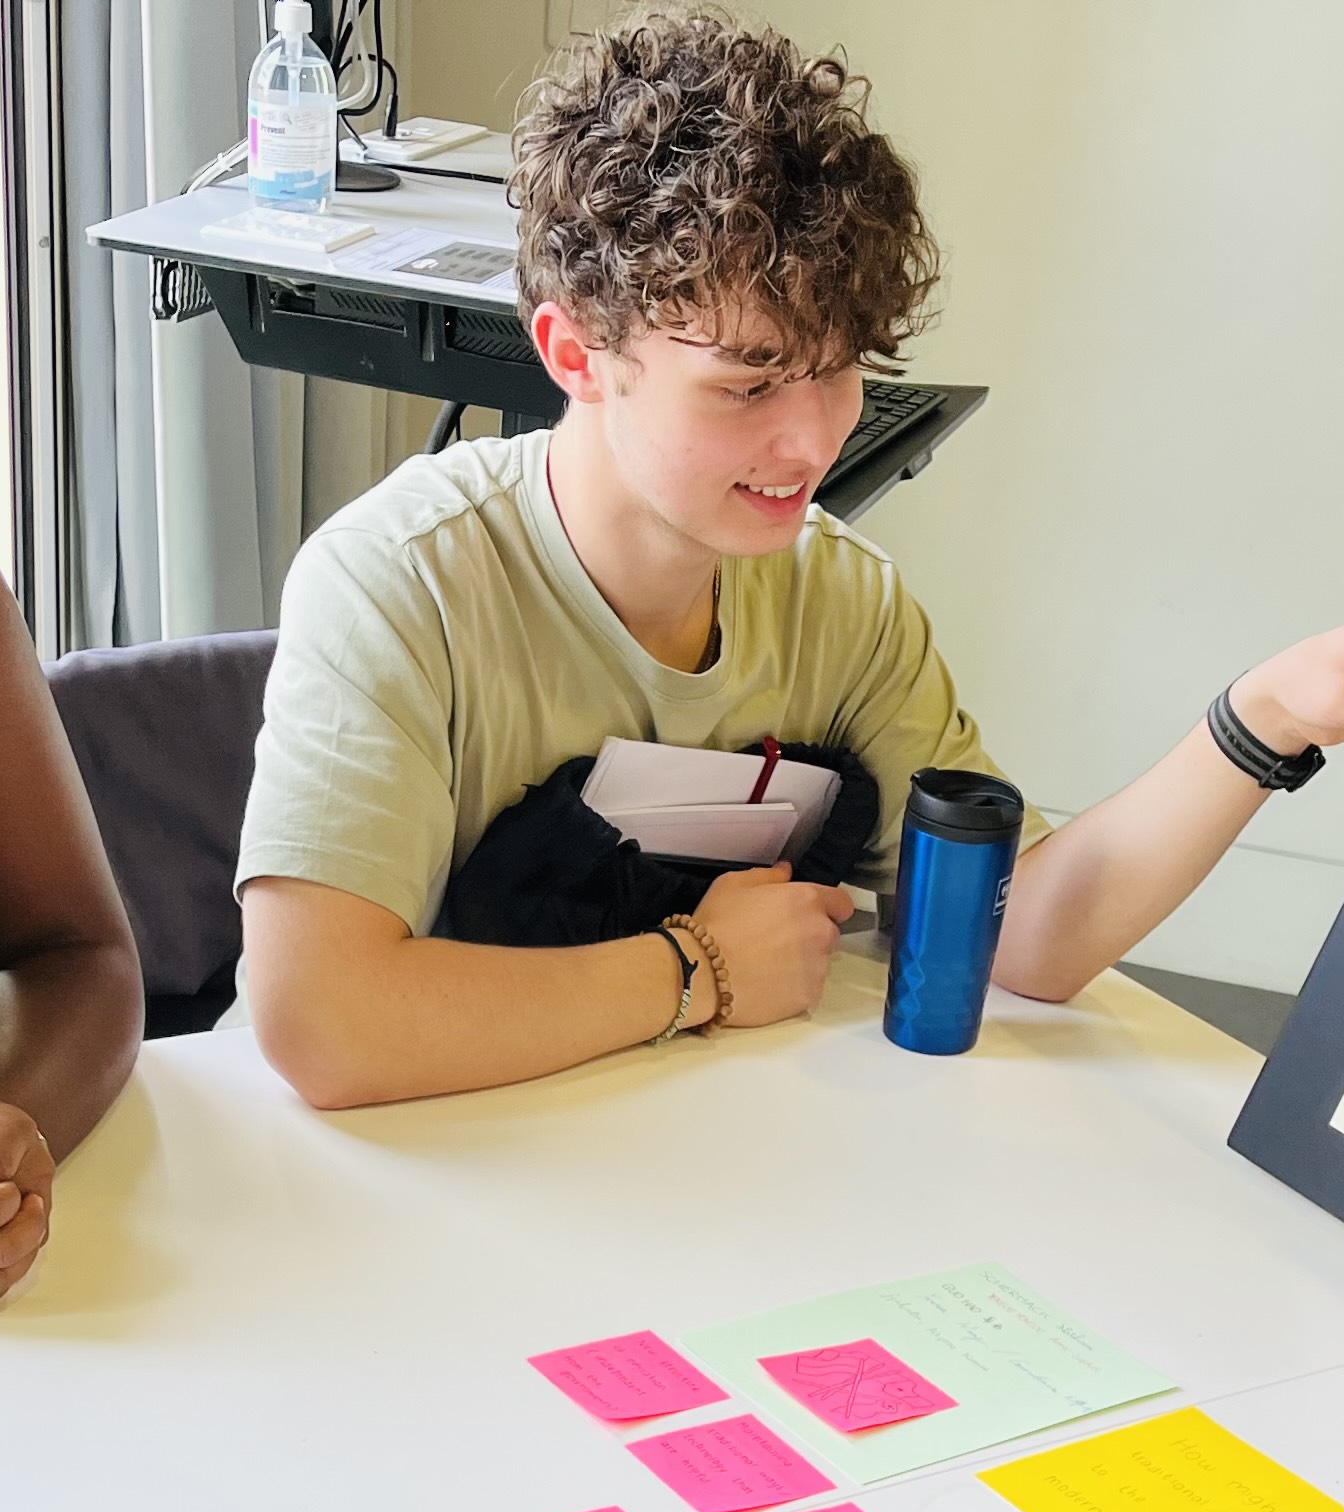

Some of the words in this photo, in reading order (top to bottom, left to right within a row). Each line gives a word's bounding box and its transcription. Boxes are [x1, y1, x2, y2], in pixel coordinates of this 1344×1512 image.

[682, 1432, 729, 1474] technology
[706, 1427, 758, 1469] traditional
[1170, 1437, 1217, 1473] How
[1091, 1462, 1110, 1478] to
[1117, 1483, 1147, 1505] the
[1130, 1449, 1210, 1508] traditional
